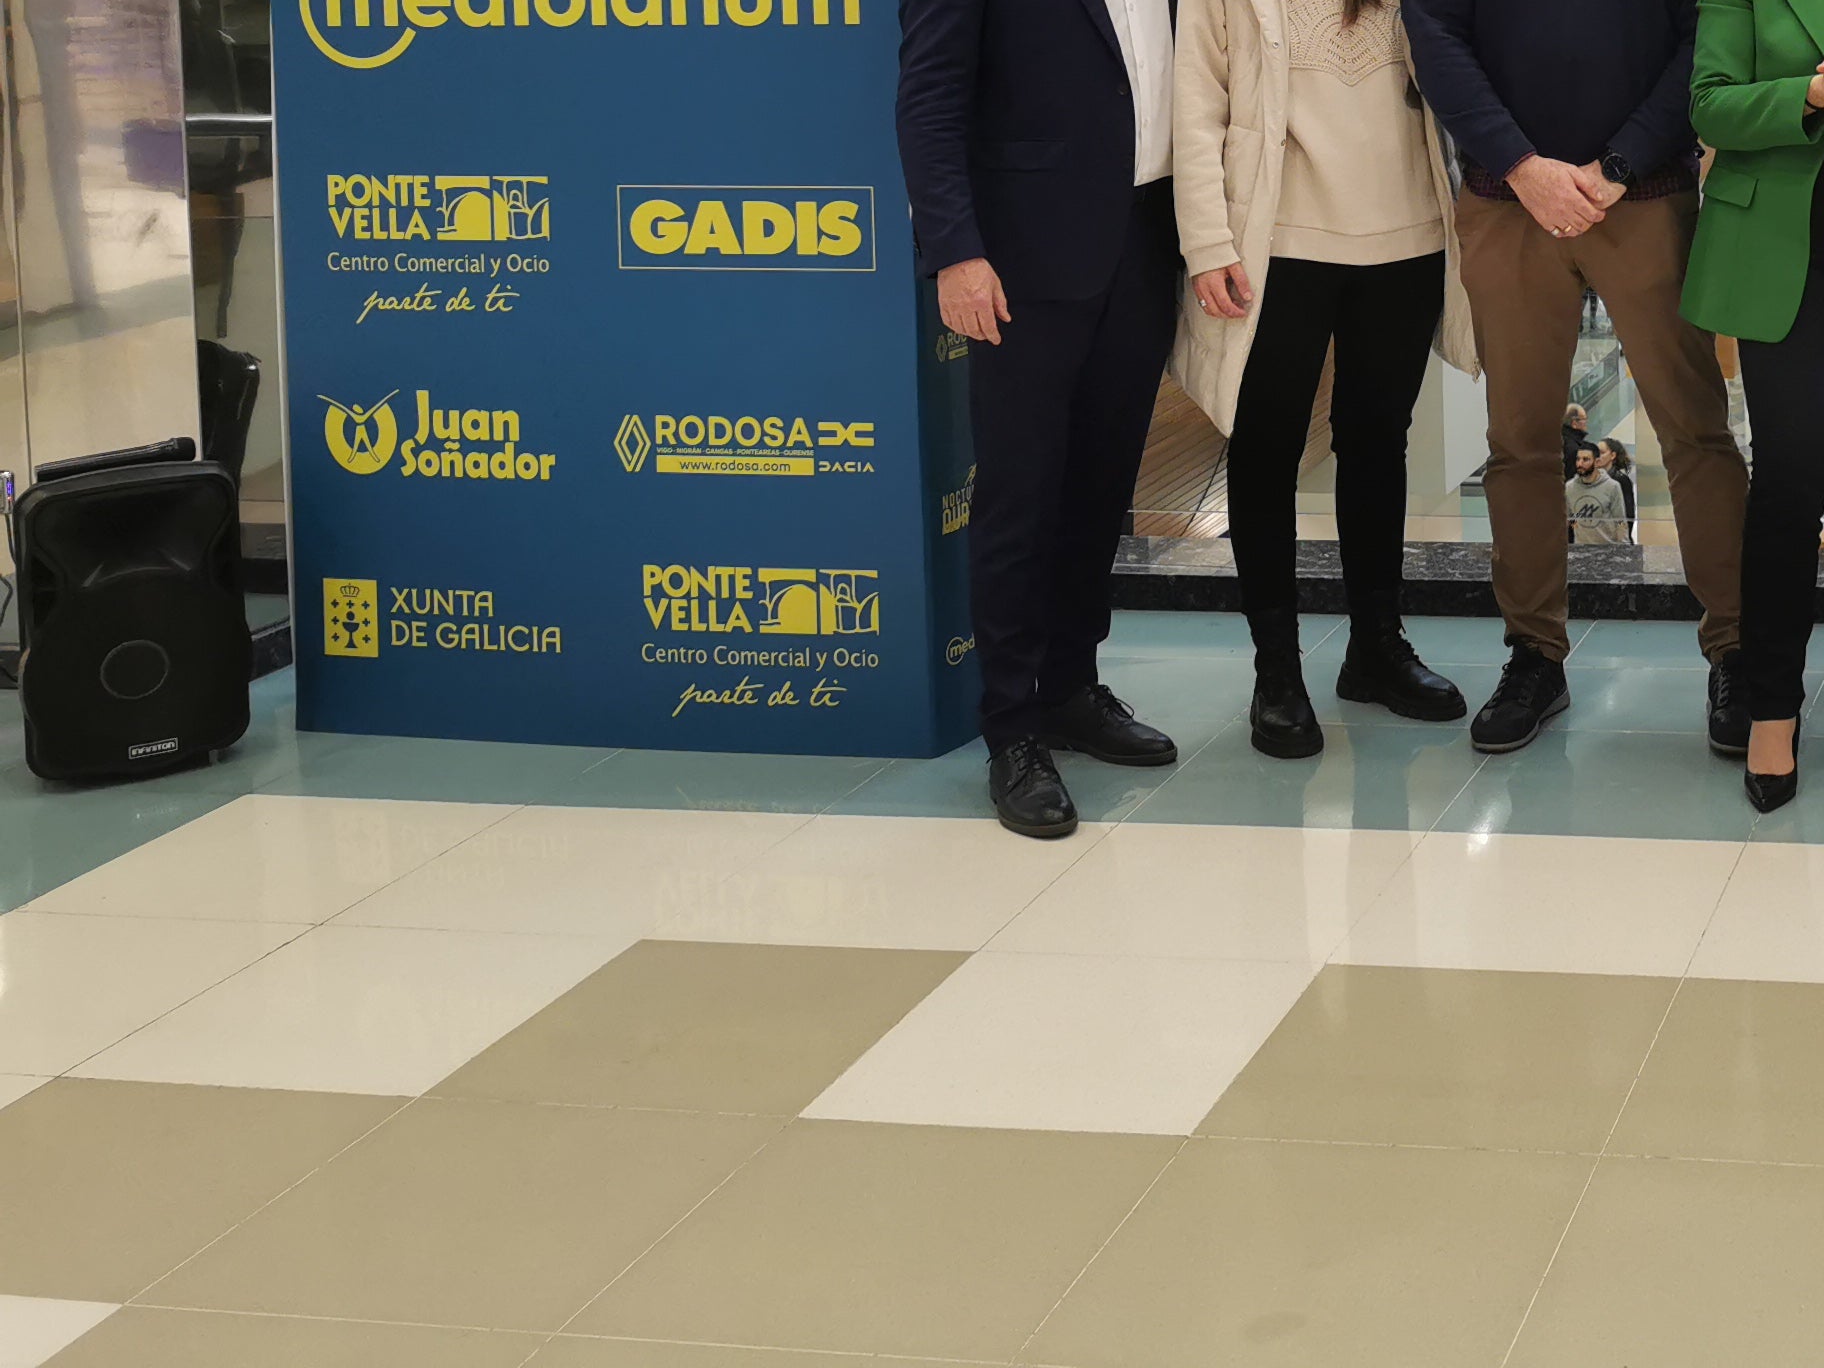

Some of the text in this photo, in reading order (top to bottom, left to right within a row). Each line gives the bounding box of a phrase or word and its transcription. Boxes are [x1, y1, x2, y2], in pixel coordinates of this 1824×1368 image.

[327, 175, 431, 208] PONTE
[329, 207, 431, 241] VELLA
[631, 201, 861, 256] GADIS
[327, 252, 550, 277] Centro Comercial y Ocio
[358, 285, 520, 323] parte de ti
[415, 390, 521, 443] Juan
[656, 416, 815, 449] RODOSA
[402, 437, 556, 482] Soñador
[678, 460, 791, 473] www.rodosa.com
[820, 462, 874, 472] DACIA
[642, 565, 754, 599] PONTE
[392, 589, 493, 617] XUNTA
[644, 598, 753, 634] VELLA
[392, 621, 561, 653] DE GALICIA
[642, 643, 880, 671] Centro Comercial y Ocio
[672, 678, 847, 717] parte de ti
